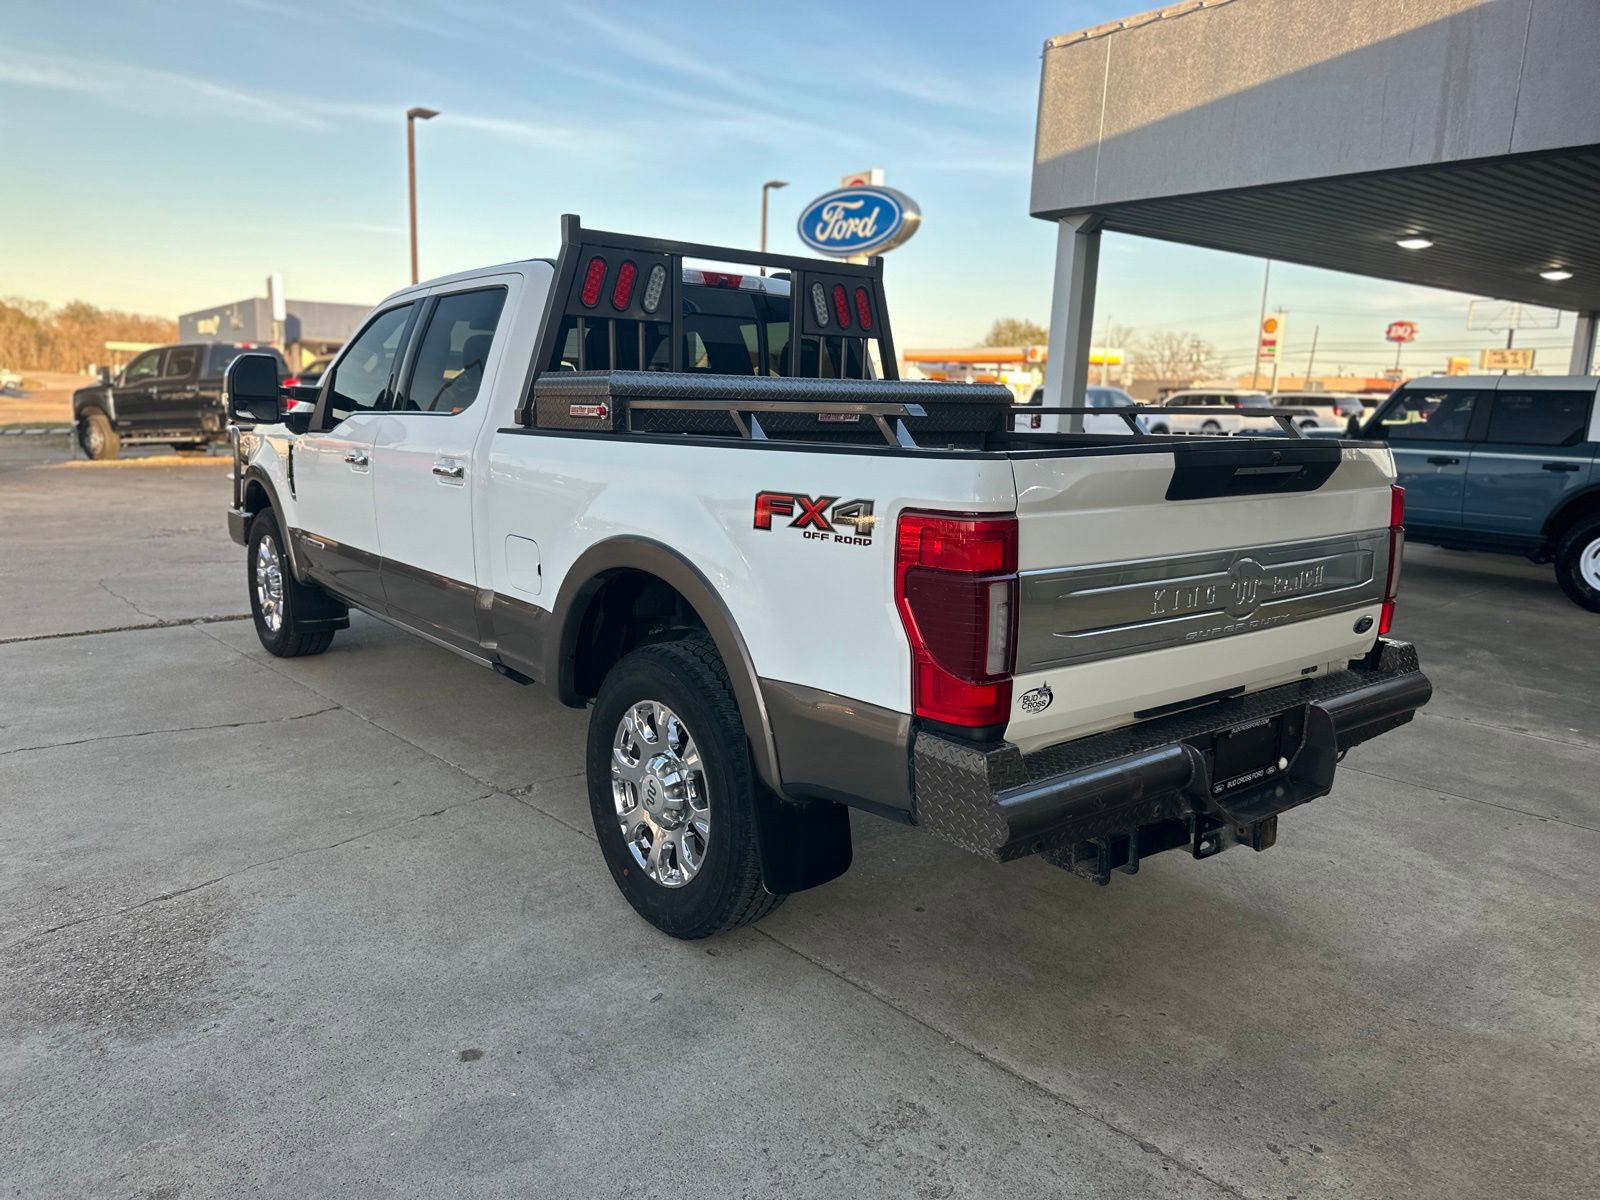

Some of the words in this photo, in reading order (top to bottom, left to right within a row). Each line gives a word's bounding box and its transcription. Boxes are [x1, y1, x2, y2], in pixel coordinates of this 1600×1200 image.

[815, 200, 881, 242] Ford
[753, 490, 876, 537] FX4
[803, 531, 829, 541] OFF
[834, 534, 873, 546] ROAD
[1150, 585, 1216, 615] KING
[1271, 565, 1324, 594] RANCH
[1185, 623, 1246, 641] SUPER
[1249, 614, 1290, 629] DUTY
[1022, 700, 1047, 710] CROSS
[1023, 694, 1038, 703] BUD
